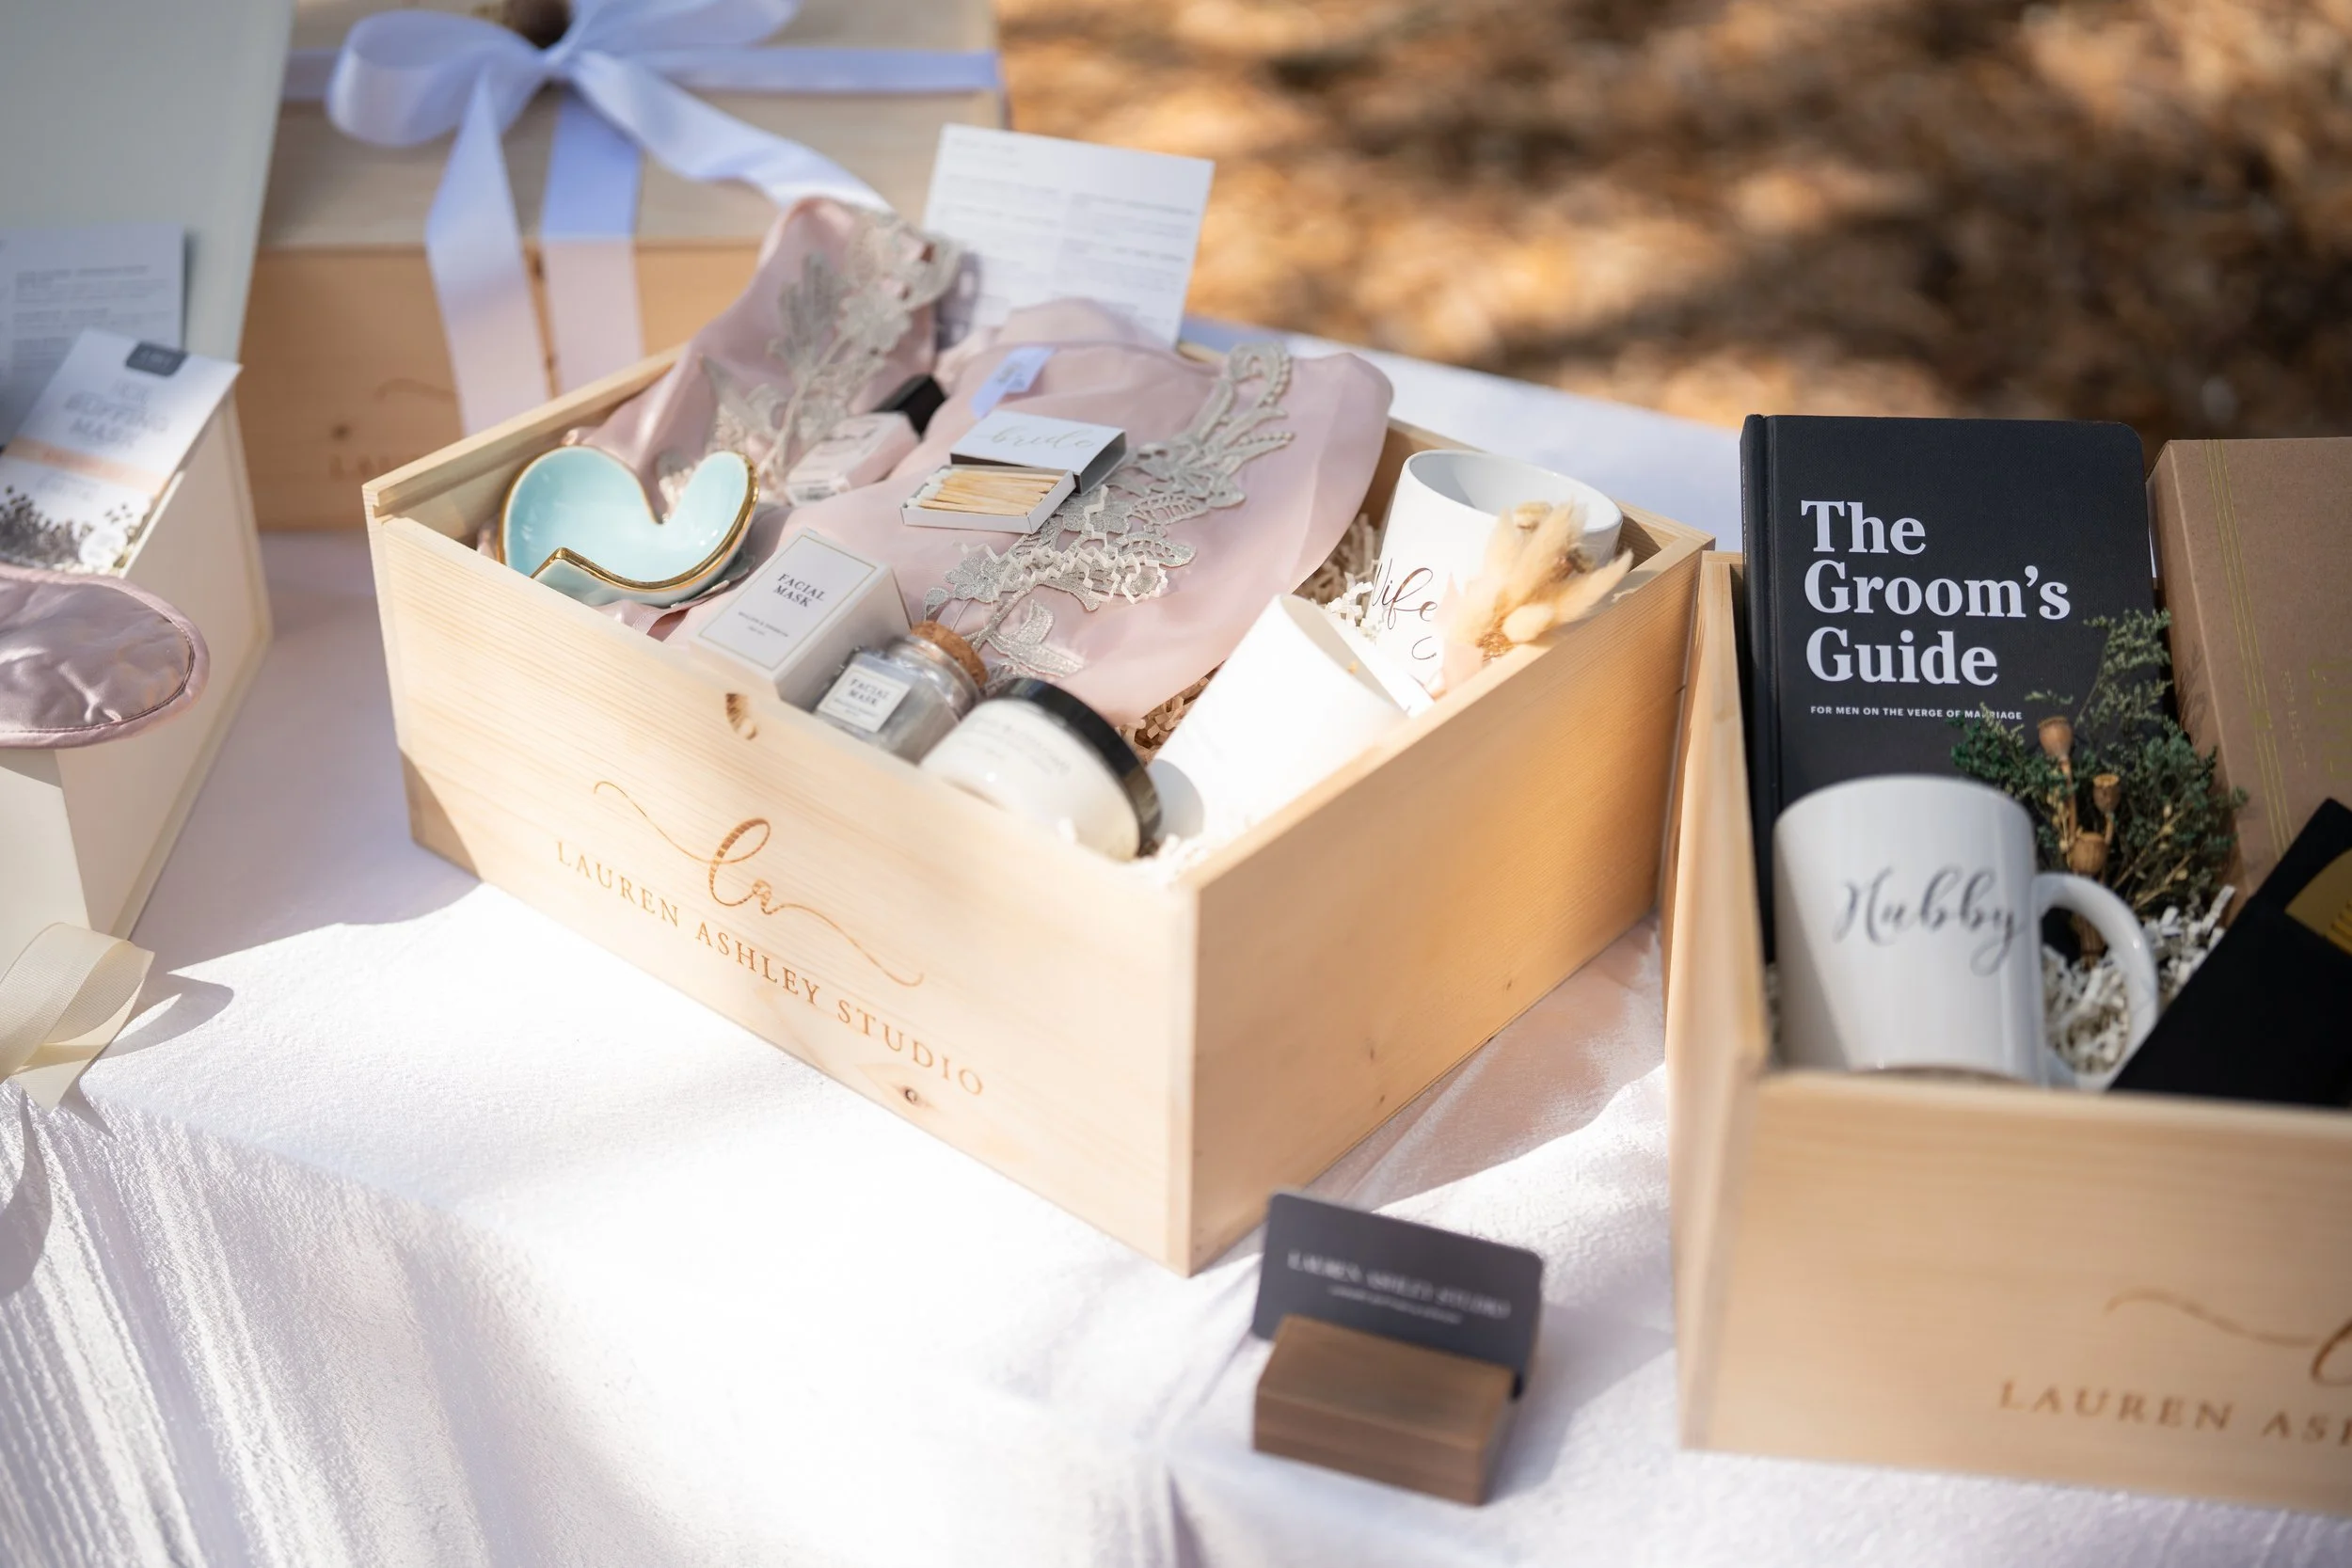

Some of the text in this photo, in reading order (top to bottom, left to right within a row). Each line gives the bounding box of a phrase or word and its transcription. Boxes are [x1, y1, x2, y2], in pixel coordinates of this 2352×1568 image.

[1801, 499, 1927, 555] The
[773, 584, 813, 608] MASK
[777, 573, 825, 602] FACIAL
[1804, 559, 2071, 620] Groom’s
[1805, 626, 1998, 687] Guide
[848, 689, 879, 708] MASK
[1810, 705, 2024, 721] FOR MEN ON THE VERGE OF MARIAGE
[1832, 865, 2028, 977] Hubby
[556, 840, 984, 1097] LAUREN ASHLEY STUDIO
[1997, 1377, 2233, 1431] LAUREN
